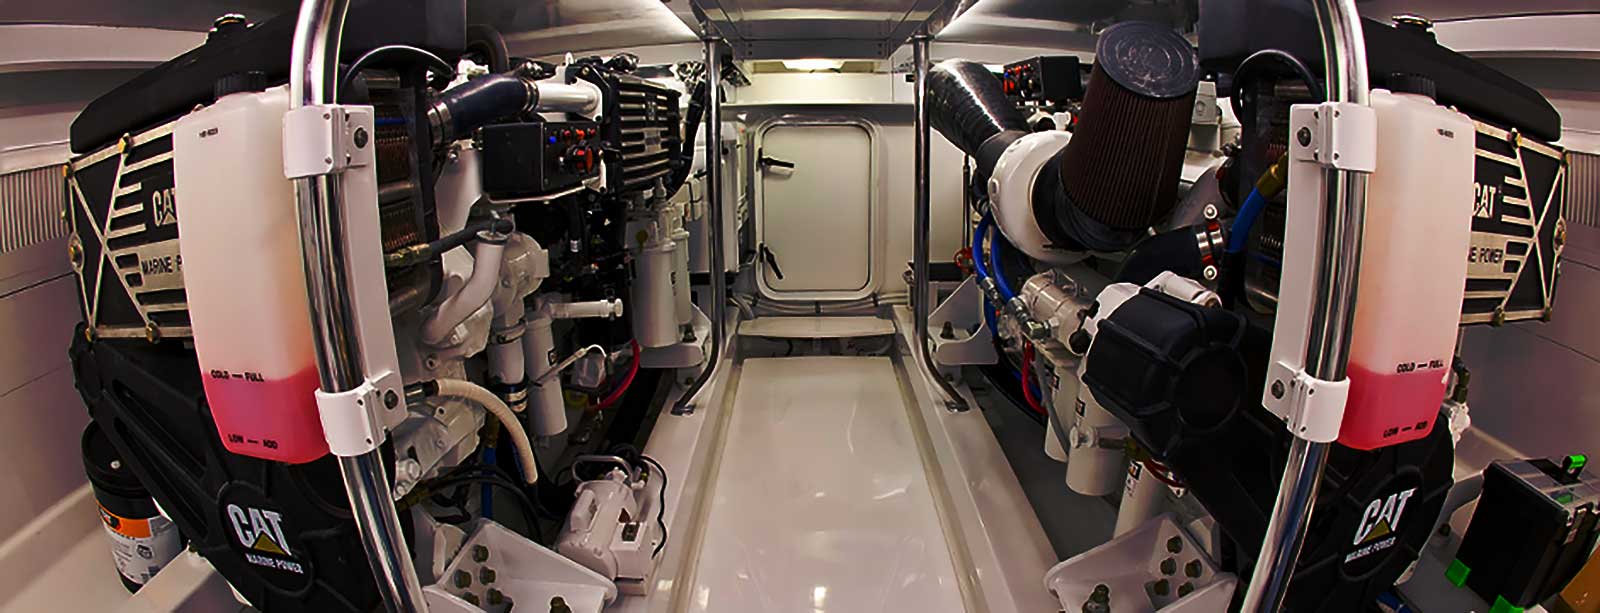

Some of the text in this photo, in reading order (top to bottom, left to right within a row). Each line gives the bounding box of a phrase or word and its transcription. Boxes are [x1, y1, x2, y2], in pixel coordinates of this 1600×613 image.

[1479, 245, 1504, 264] POWER
[141, 256, 174, 275] MARINE
[210, 369, 265, 382] COLD FULL
[1396, 360, 1444, 374] COLD FULL
[227, 433, 279, 450] LOW ADD
[1383, 427, 1399, 438] LOW
[1353, 486, 1418, 546] CAT
[227, 504, 292, 556] CAT
[245, 552, 304, 574] MARINE POWER
